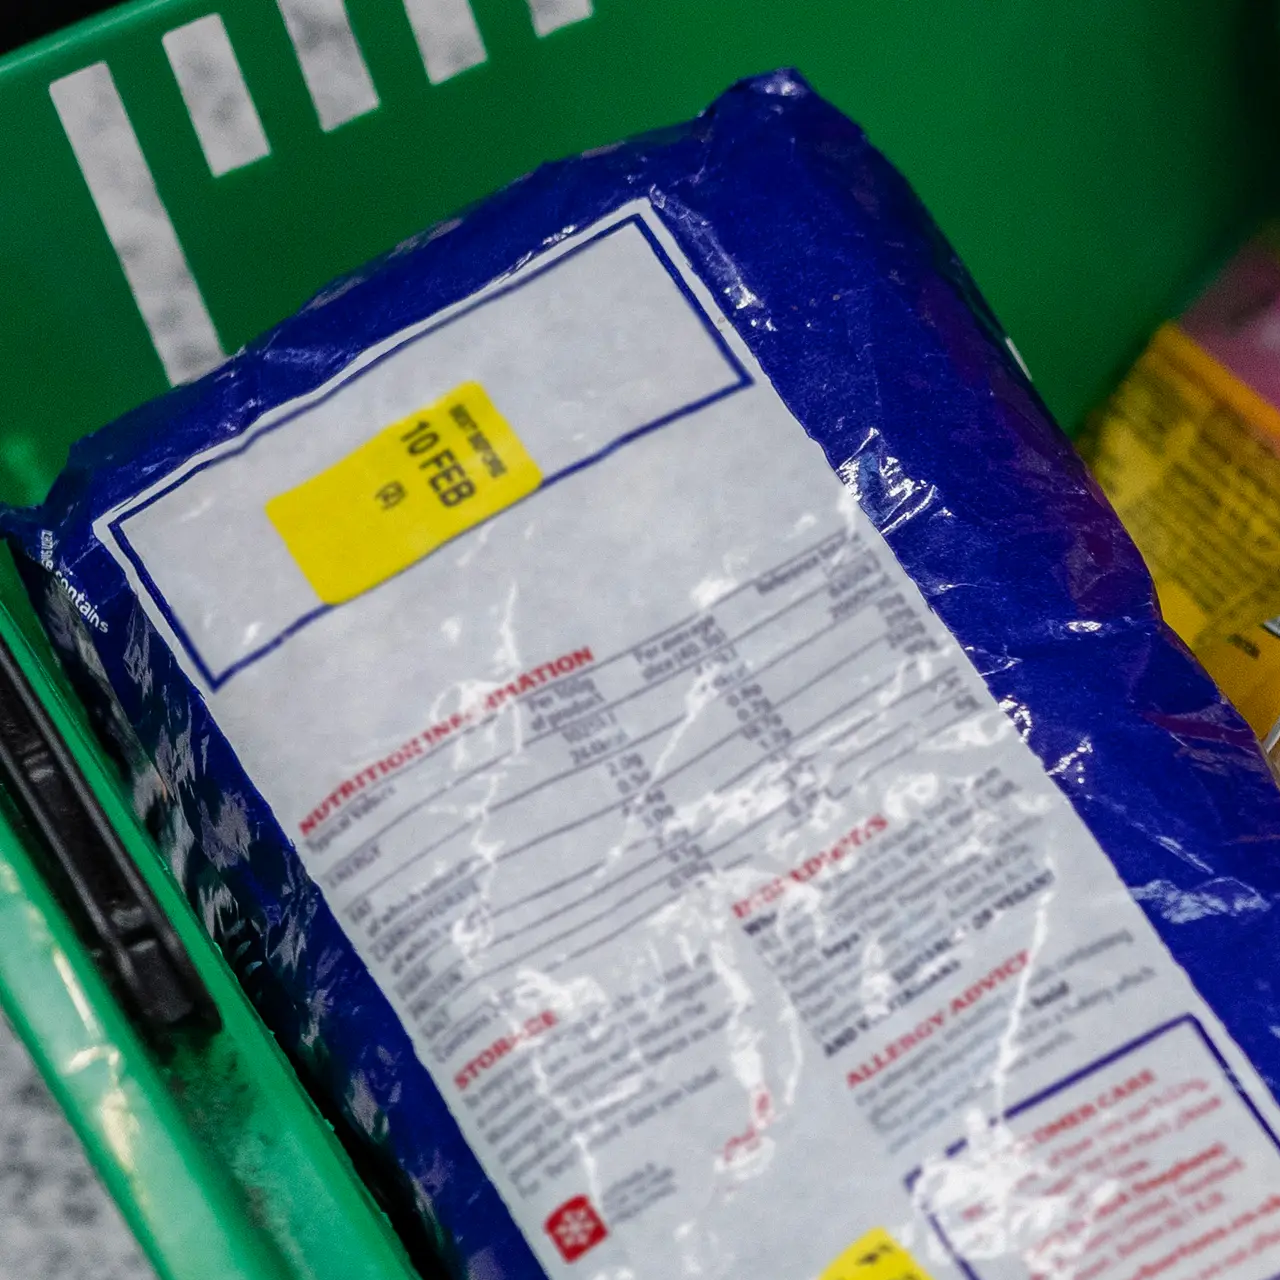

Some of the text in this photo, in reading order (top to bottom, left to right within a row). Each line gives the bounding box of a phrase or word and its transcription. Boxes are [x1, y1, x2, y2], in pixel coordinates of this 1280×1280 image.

[401, 421, 476, 508] 10 FEB
[298, 739, 422, 838] NUTRITION
[846, 1010, 955, 1089] ALLERGY
